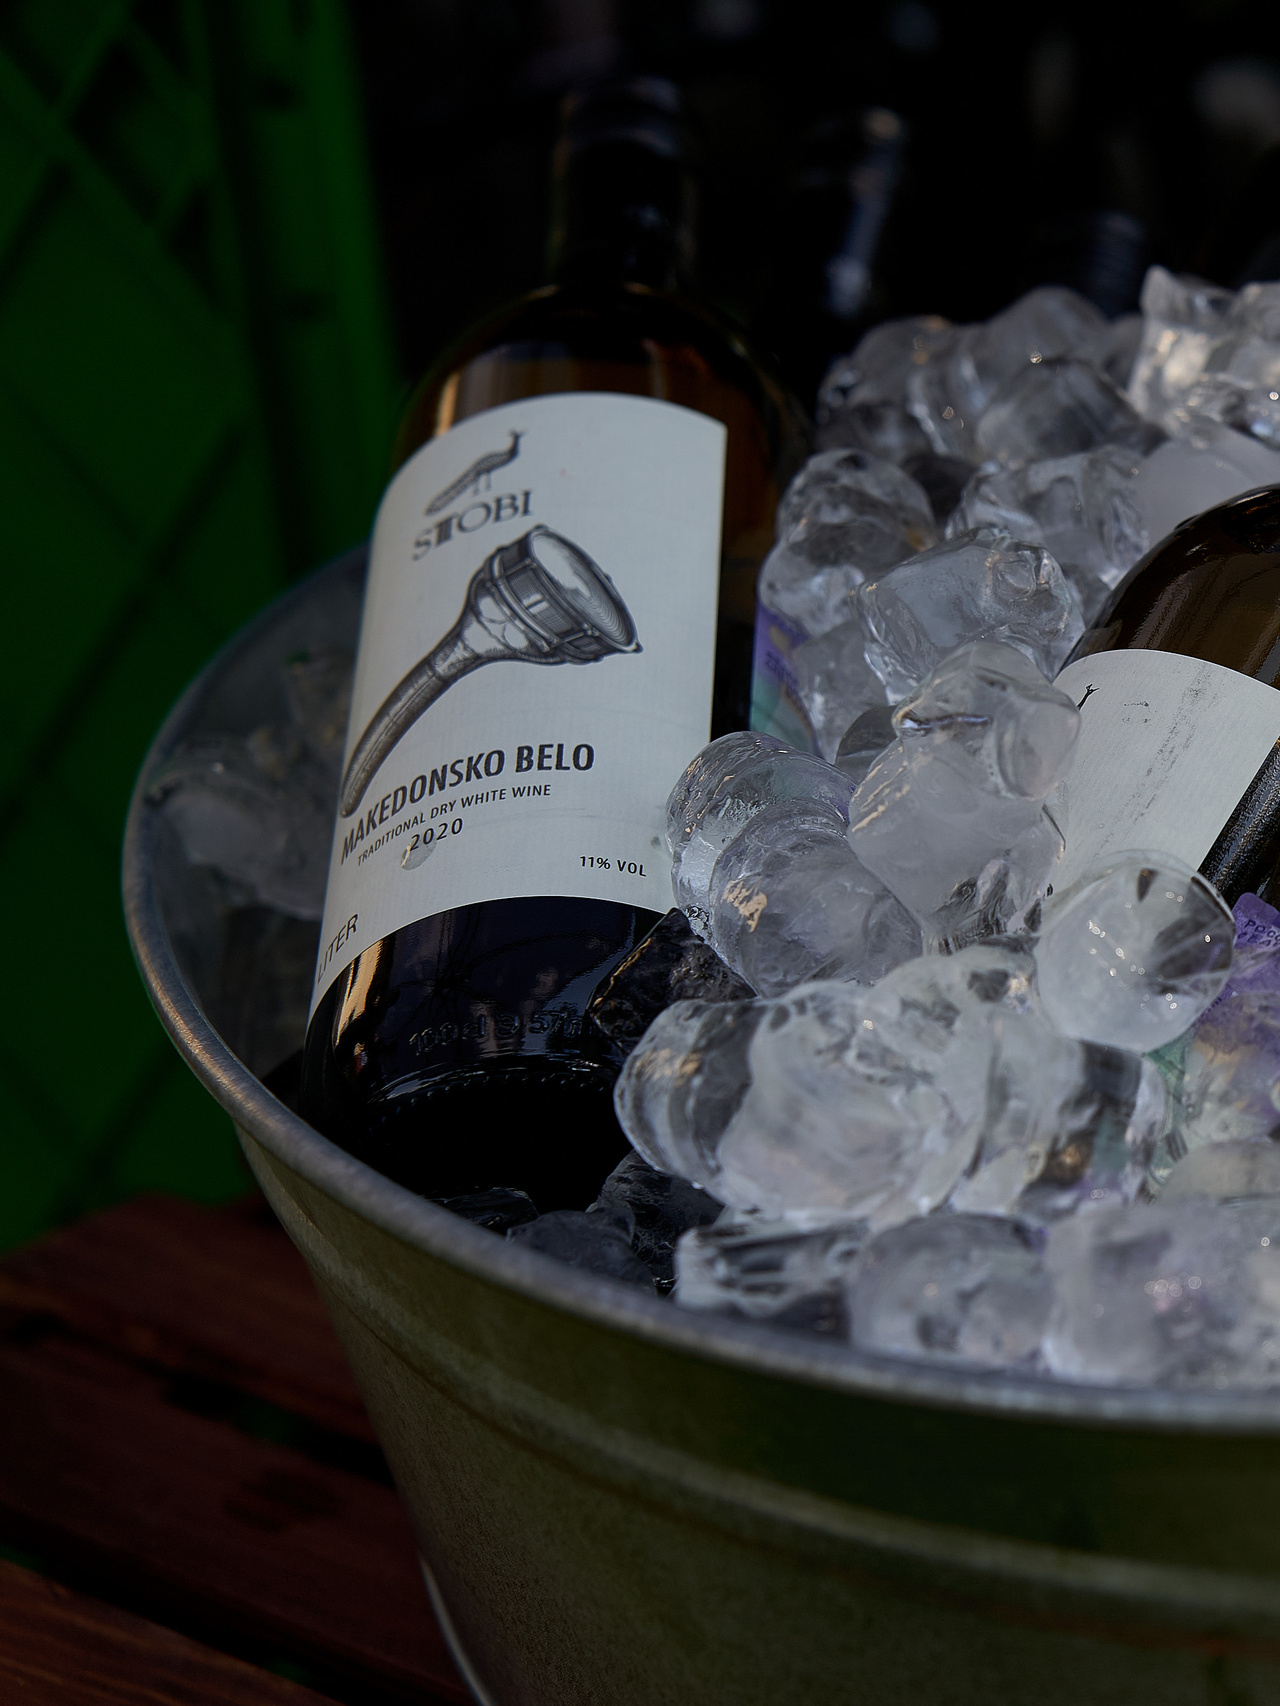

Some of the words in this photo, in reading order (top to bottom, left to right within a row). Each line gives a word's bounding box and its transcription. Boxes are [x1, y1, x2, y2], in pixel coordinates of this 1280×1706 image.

[411, 489, 535, 562] STOBI
[340, 749, 506, 866] MAKEDONSKO
[514, 743, 596, 774] BELO
[356, 811, 427, 867] TRADITIONAL
[429, 799, 458, 820] DRY
[460, 788, 508, 809] WHITE
[511, 784, 552, 799] WINE
[409, 817, 464, 852] 2020
[579, 855, 612, 871] 11%
[616, 859, 648, 878] VOL
[317, 912, 359, 985] LITER
